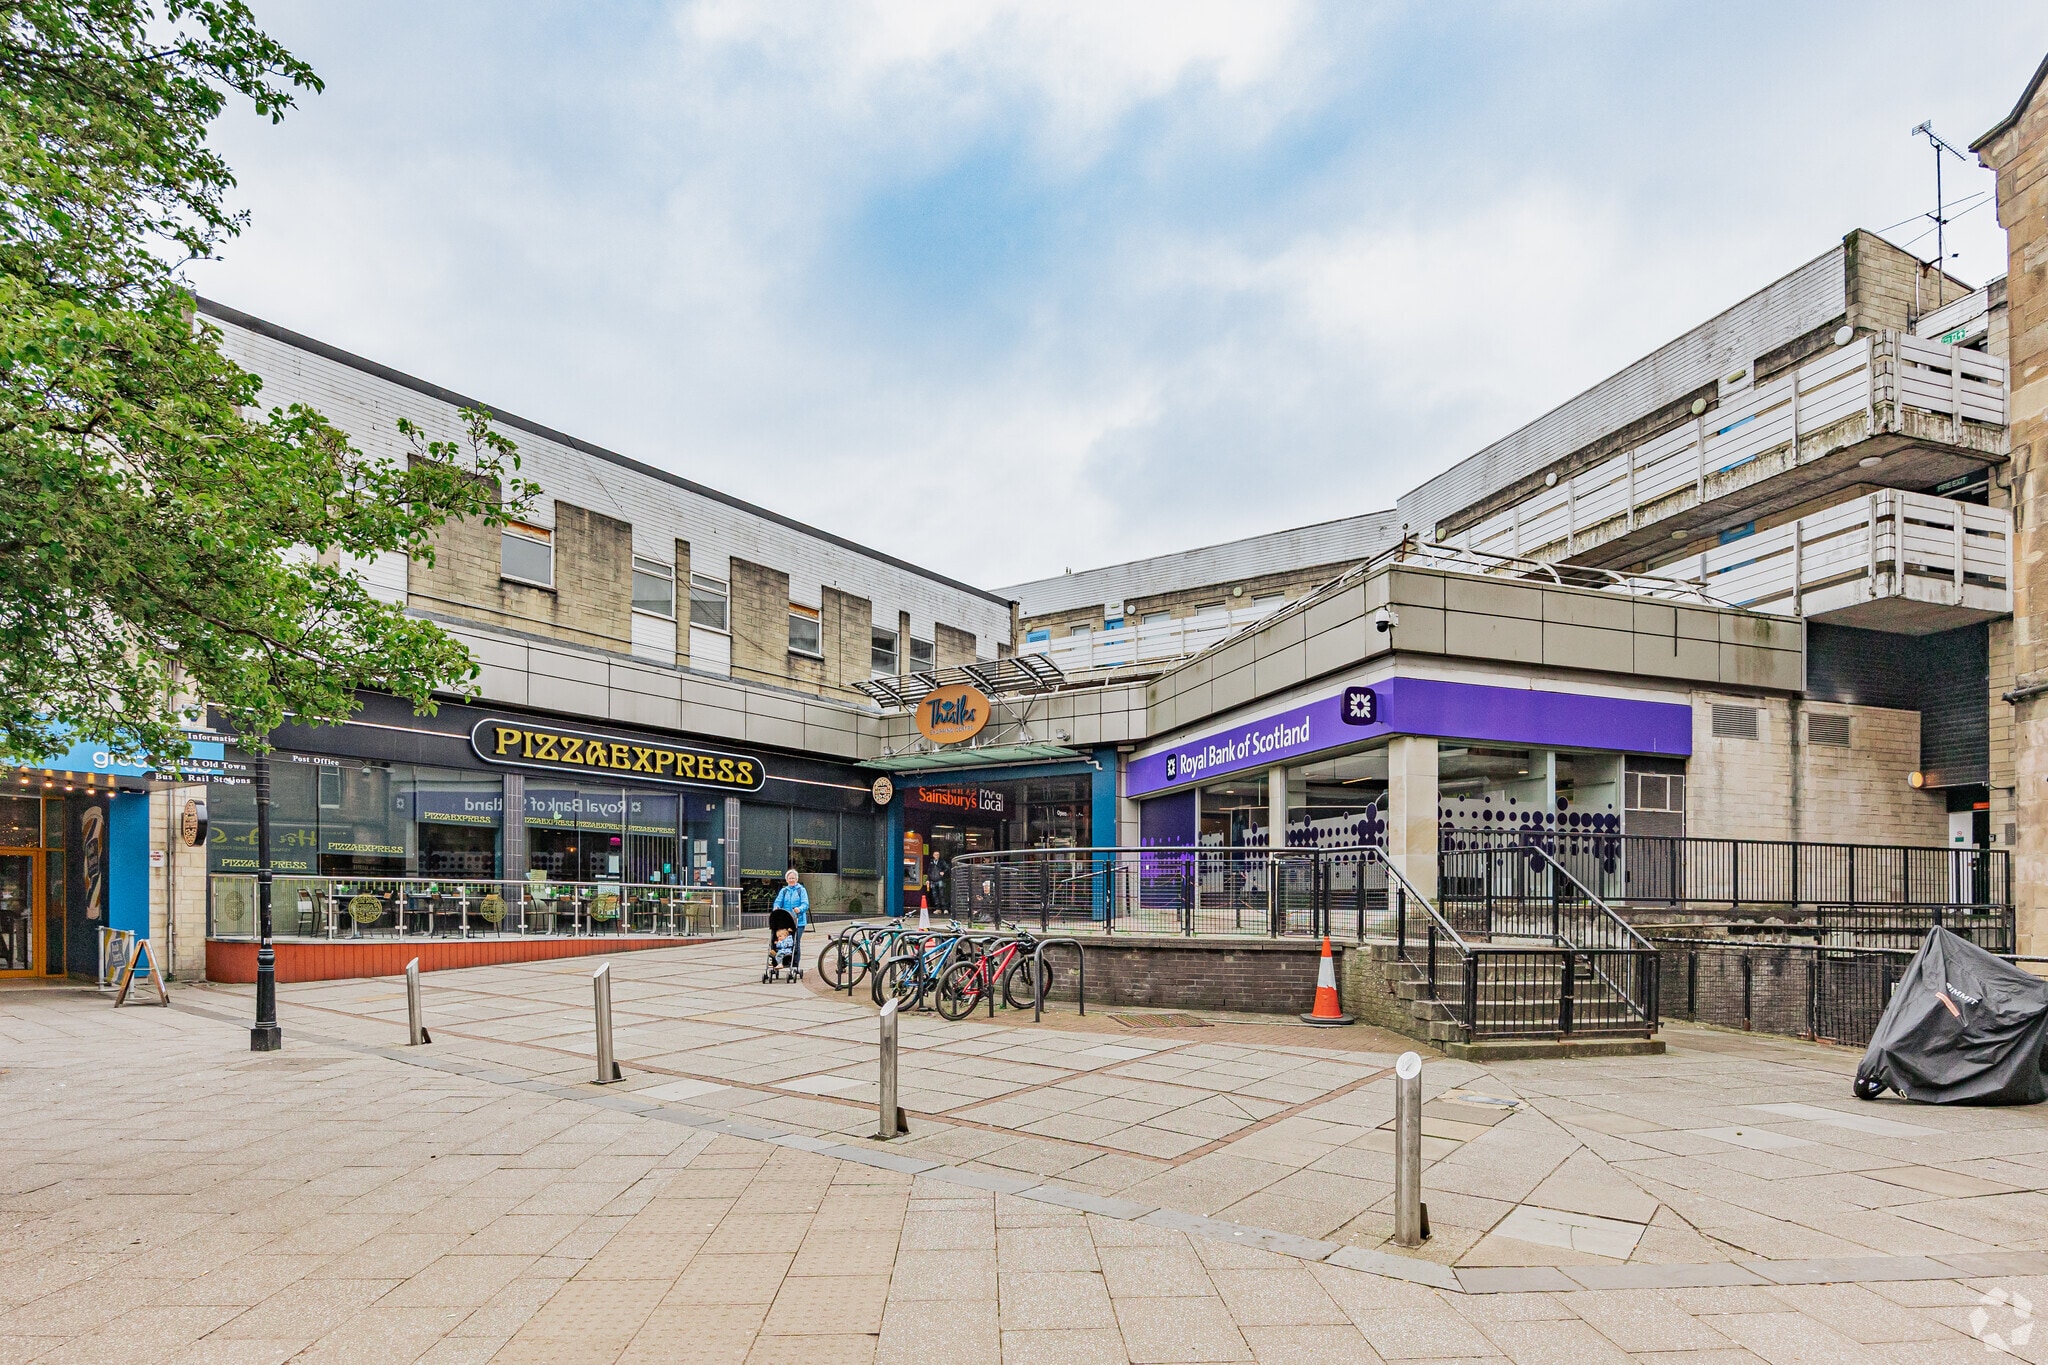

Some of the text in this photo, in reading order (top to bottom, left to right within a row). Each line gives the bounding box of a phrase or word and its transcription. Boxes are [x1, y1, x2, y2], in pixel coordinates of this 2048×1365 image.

[926, 694, 977, 728] Thistles
[188, 731, 239, 743] Informatio
[1180, 715, 1310, 778] Royal Bank of Scotland
[292, 755, 340, 766] Post Office
[495, 727, 754, 785] PIZZAEXPRESS
[159, 758, 189, 767] Ctle
[192, 760, 200, 768] &
[202, 760, 219, 769] Old
[221, 761, 247, 771] Town
[155, 772, 173, 781] Bus
[188, 774, 209, 783] Rail
[919, 786, 977, 811] Sainsbury's
[979, 791, 1004, 812] Local
[424, 812, 491, 823] PIZZAEXPRESS
[524, 817, 574, 827] IZZAEXPRESS
[628, 824, 676, 834] PIZZAEXPRESS
[328, 842, 404, 853] PIZZAEXPRESS
[221, 858, 307, 869] PIZZAEPRESS
